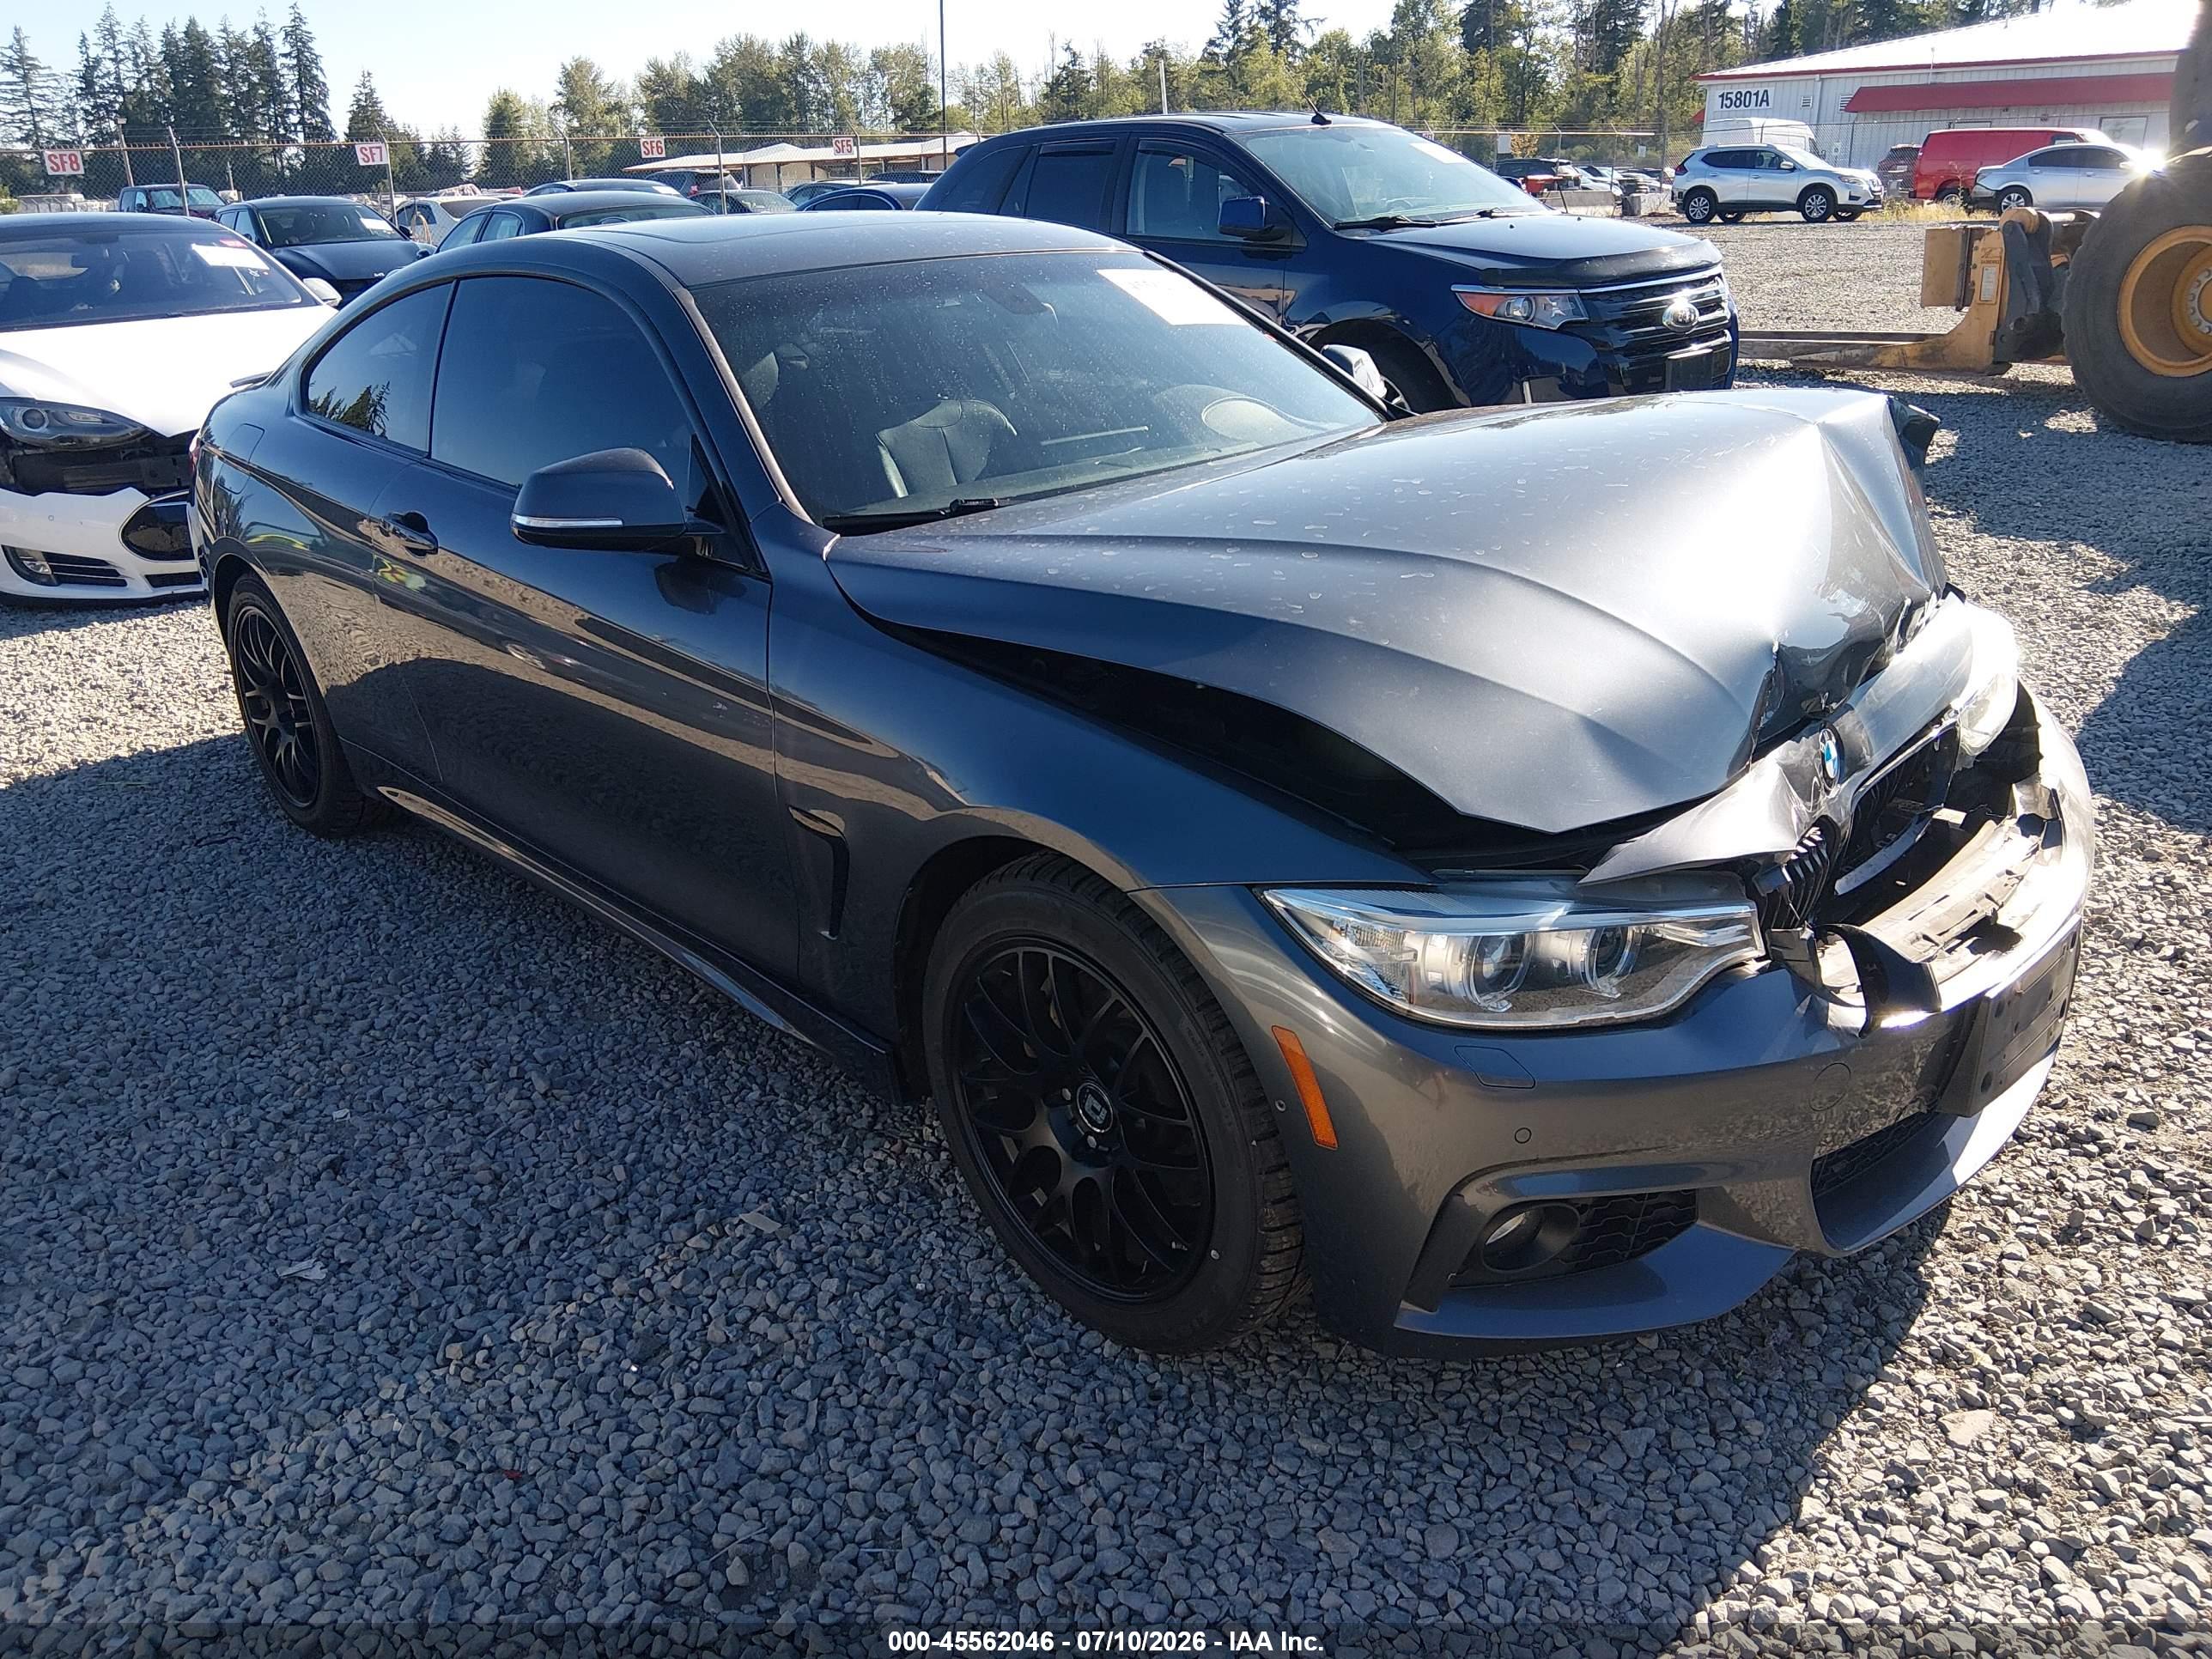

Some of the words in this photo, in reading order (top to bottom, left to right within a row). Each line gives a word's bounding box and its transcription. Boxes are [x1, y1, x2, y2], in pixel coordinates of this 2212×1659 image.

[1718, 89, 1770, 109] 15801A
[359, 146, 383, 163] SF7
[641, 140, 663, 155] SF6
[834, 139, 853, 154] SF5
[47, 153, 81, 172] SF8
